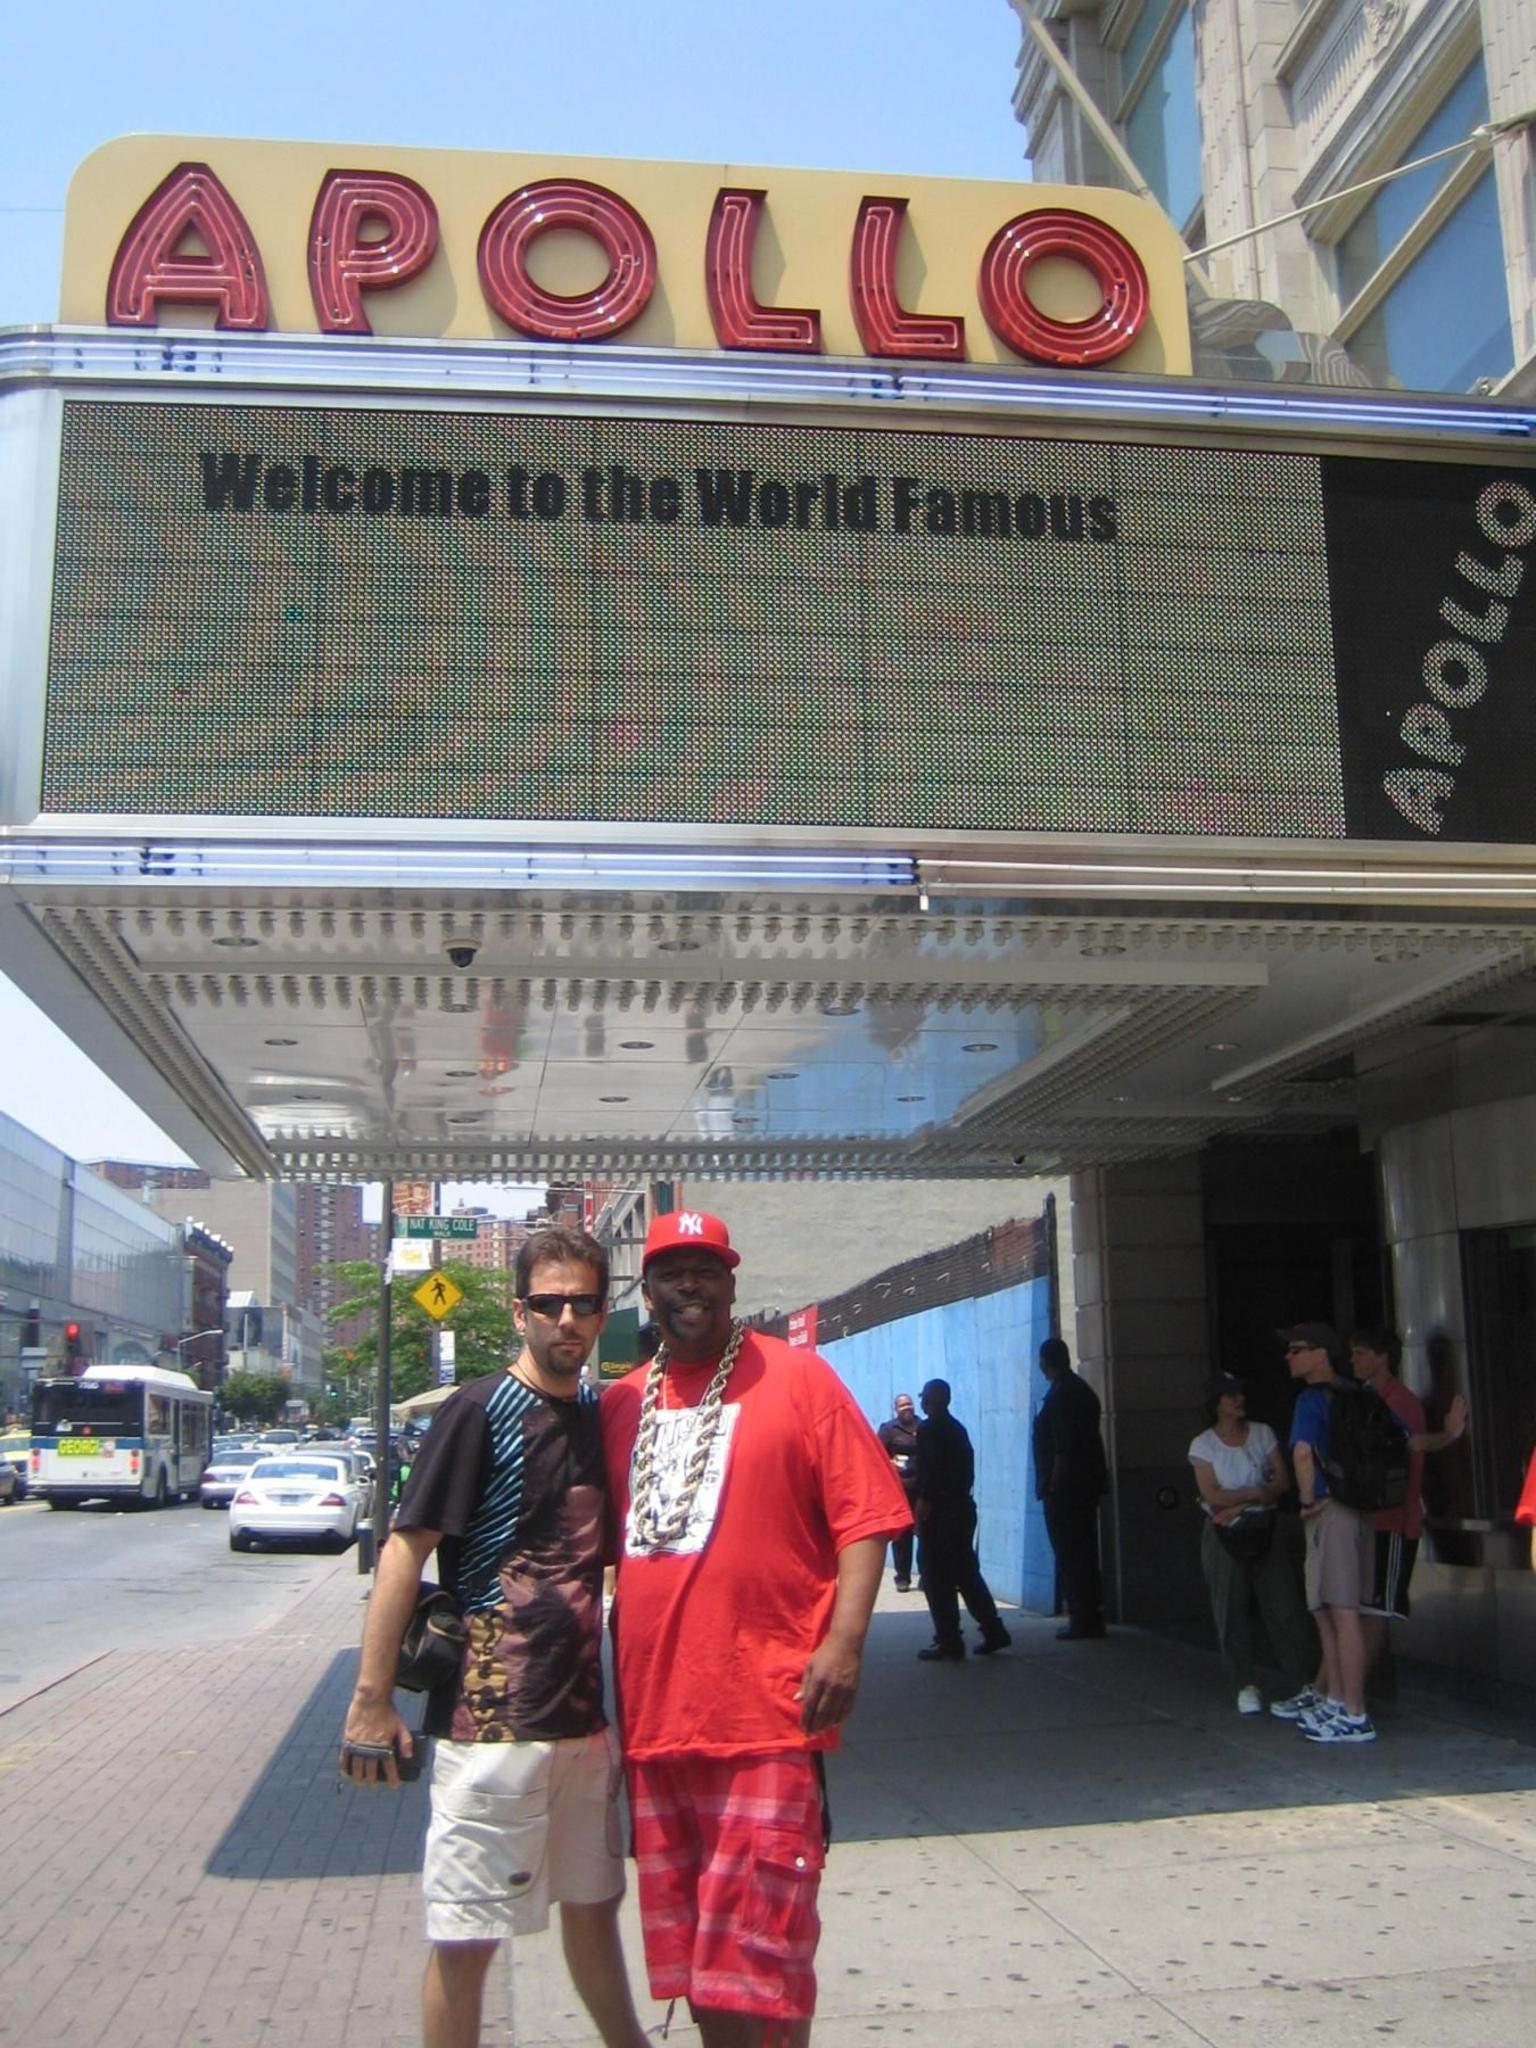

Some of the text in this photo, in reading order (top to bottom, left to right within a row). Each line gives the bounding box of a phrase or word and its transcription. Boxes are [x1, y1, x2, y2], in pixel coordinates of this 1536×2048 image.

[105, 162, 1151, 368] APOLLO
[202, 453, 1118, 543] Welcome to the World Famous
[1383, 479, 1536, 836] APOLLO
[409, 1218, 475, 1232] NAT KING COLE
[678, 1211, 703, 1236] NY
